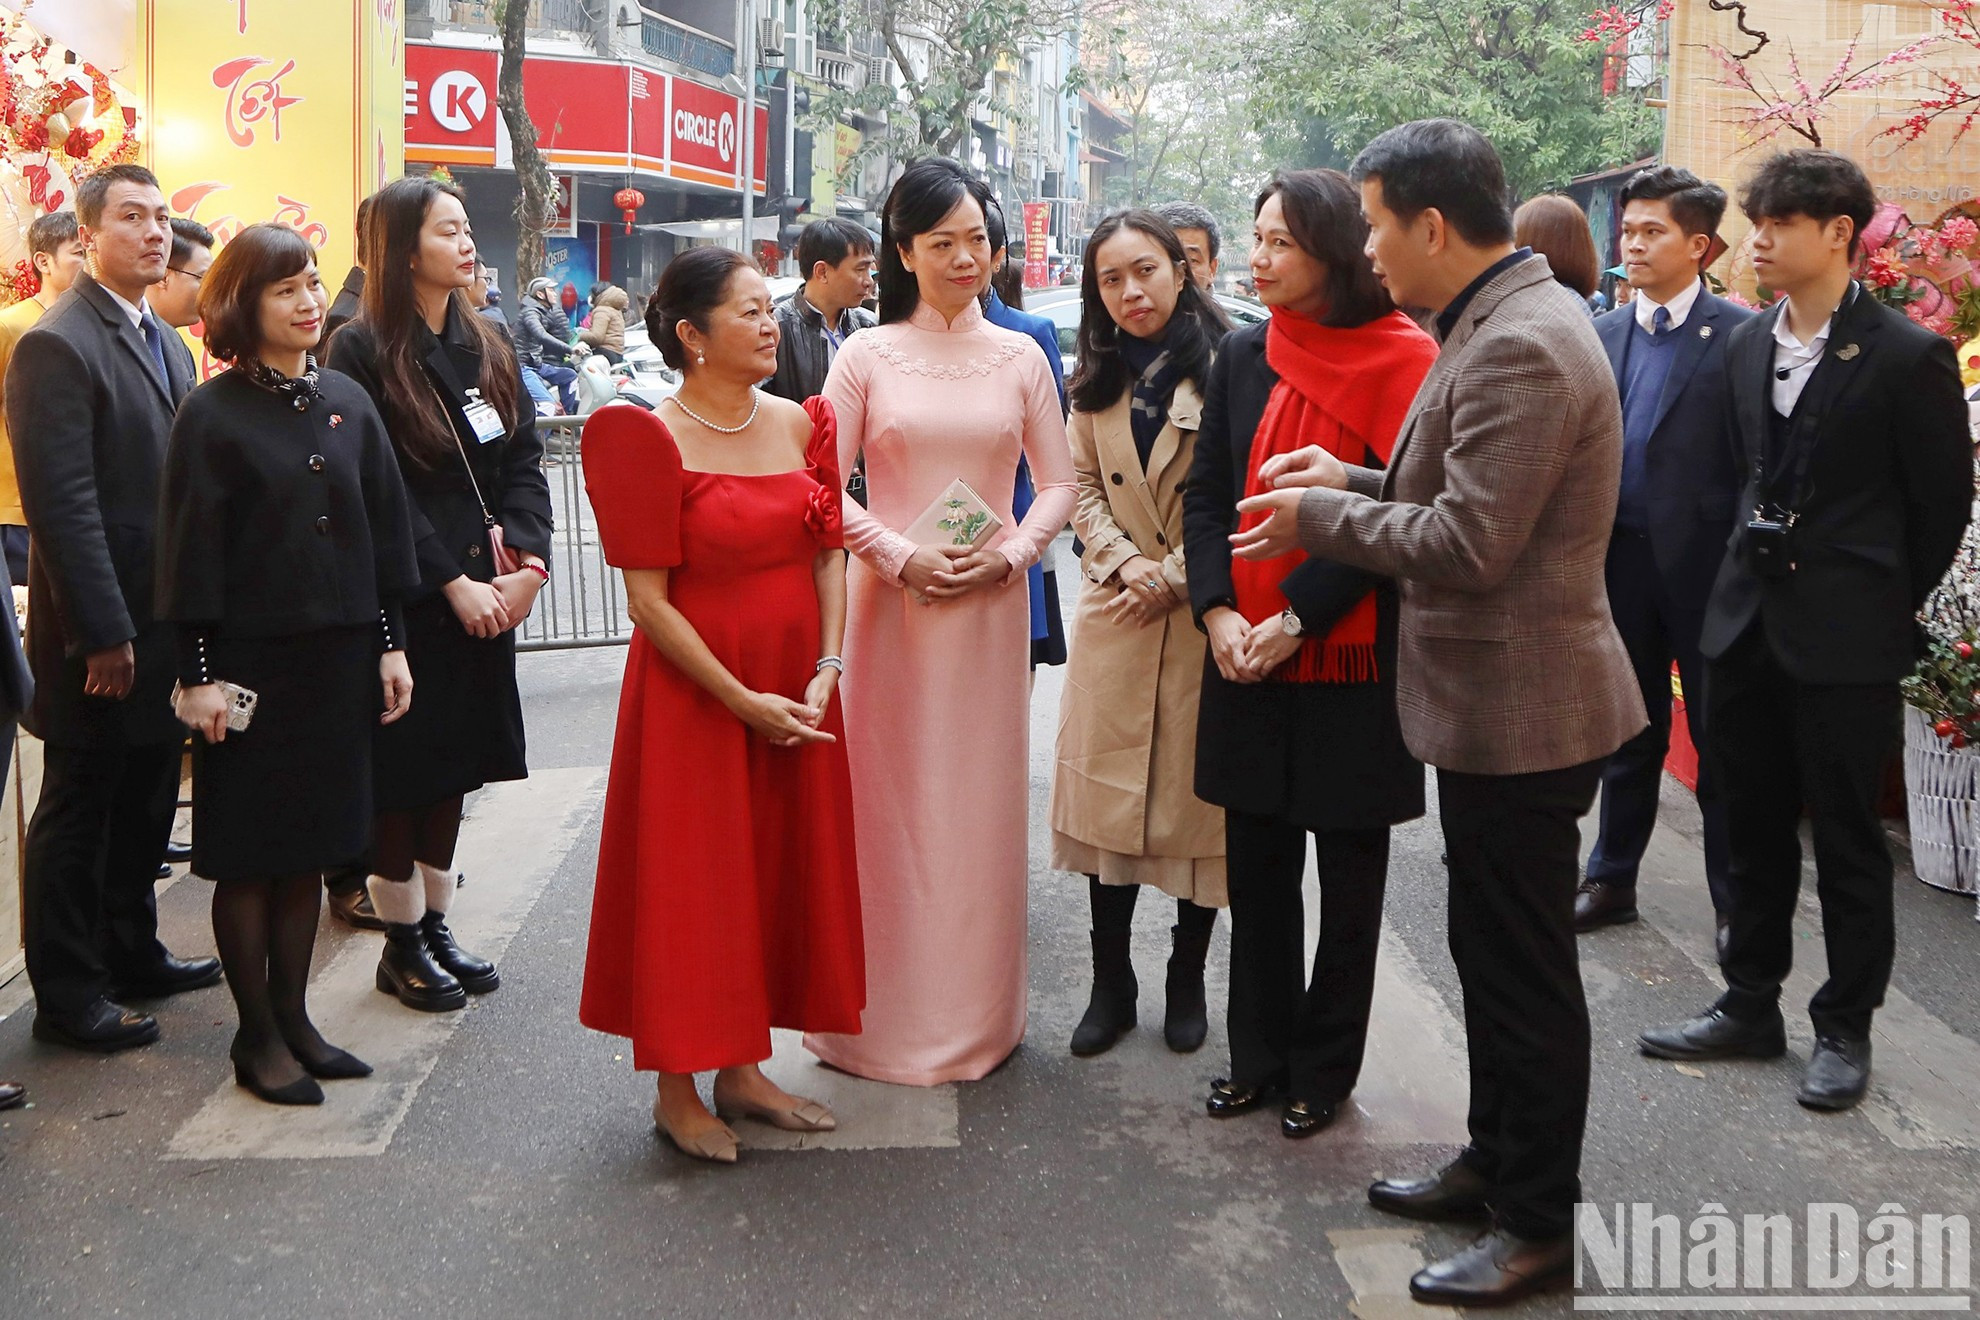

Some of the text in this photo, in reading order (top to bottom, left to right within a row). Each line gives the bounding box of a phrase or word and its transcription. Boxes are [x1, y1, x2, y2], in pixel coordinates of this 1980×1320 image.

[211, 57, 304, 147] Tết
[444, 82, 483, 130] K
[674, 108, 733, 161] CIRCLE K
